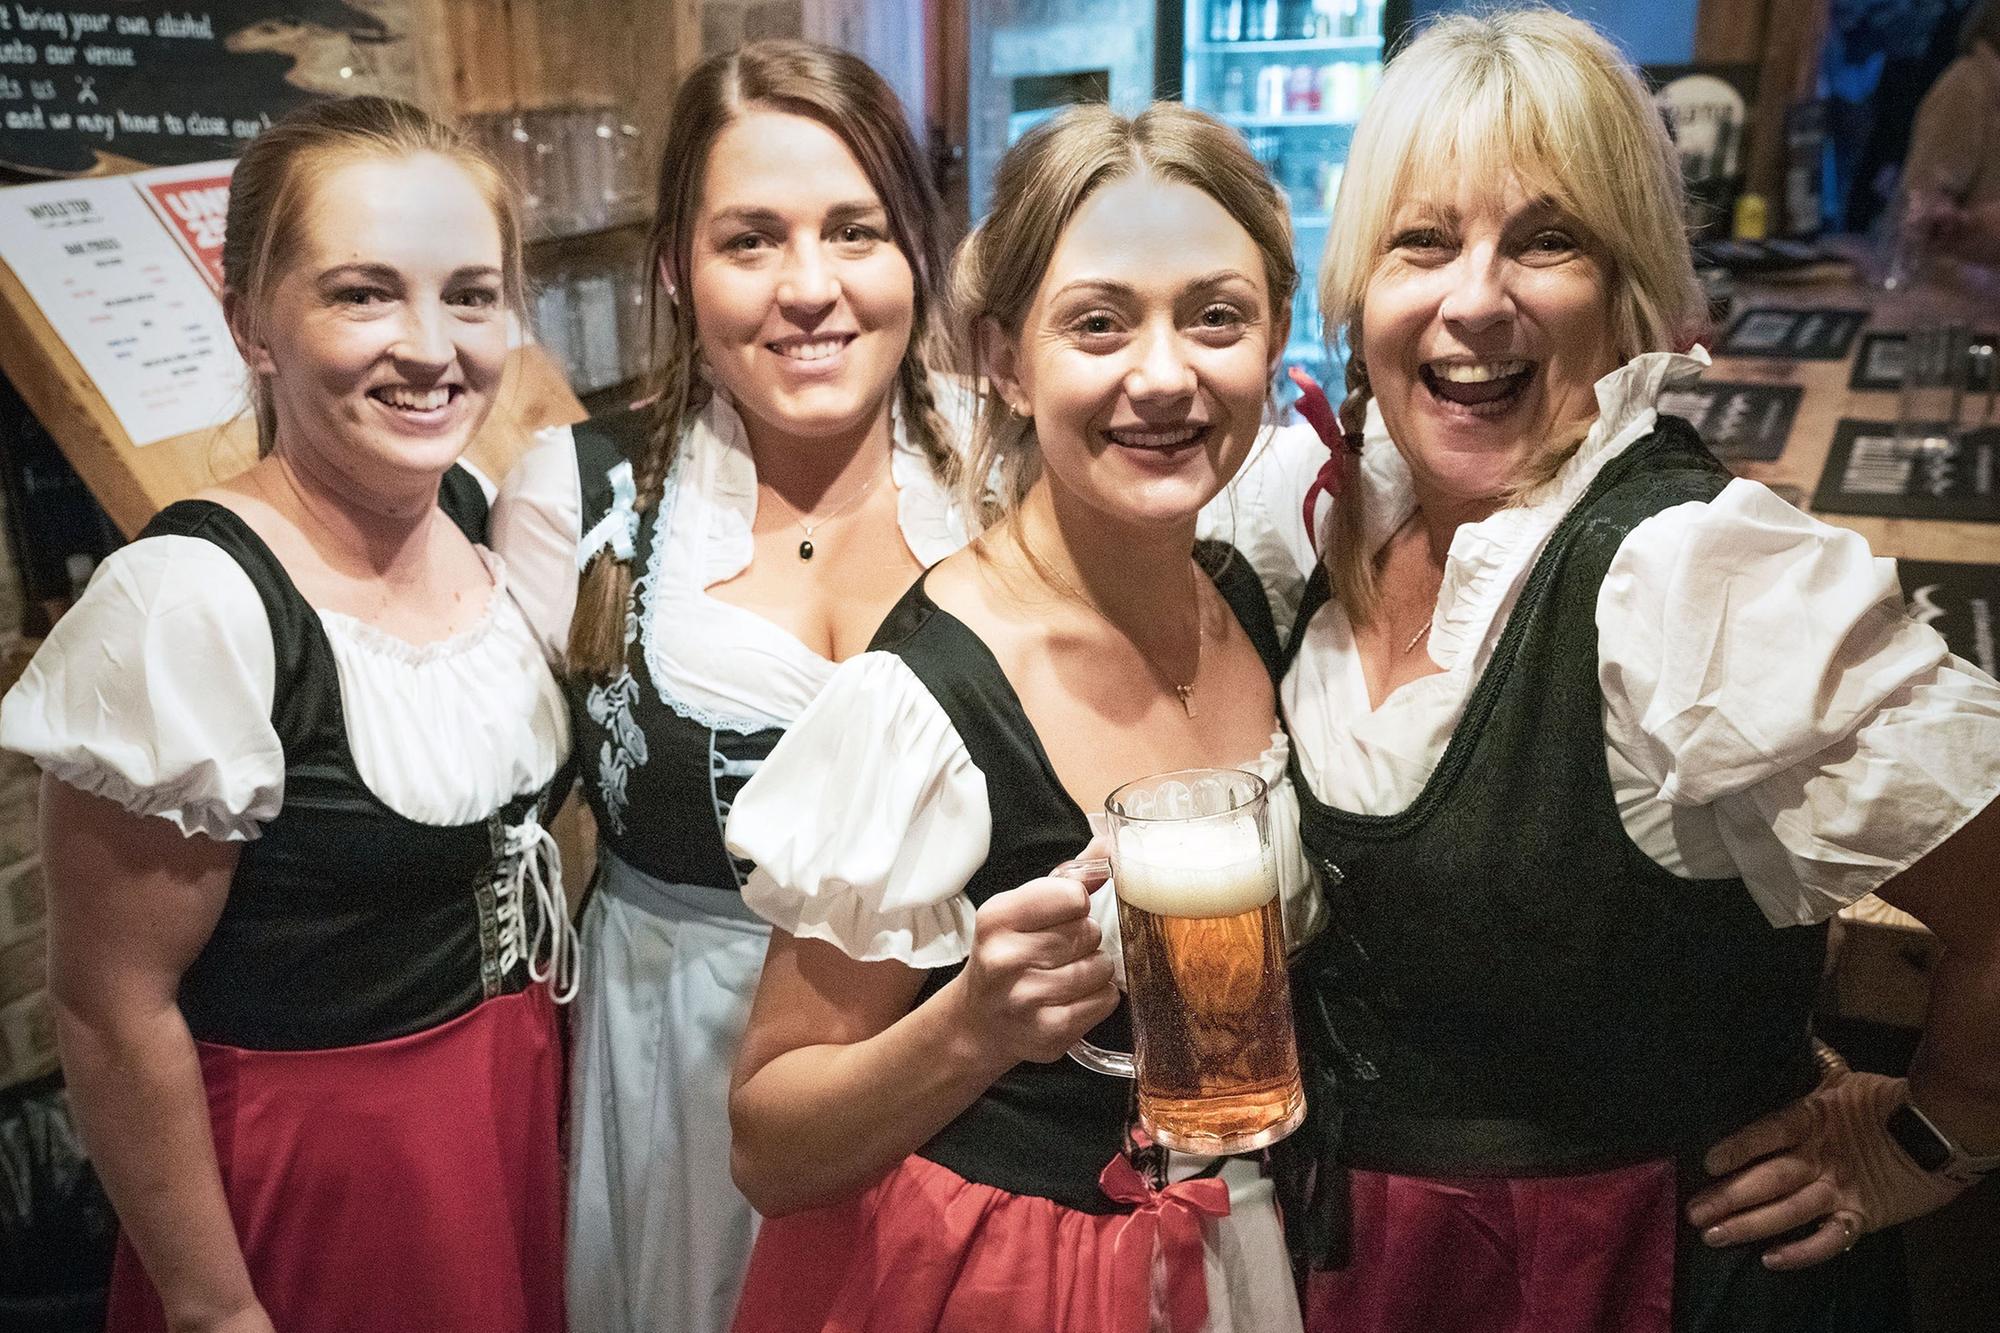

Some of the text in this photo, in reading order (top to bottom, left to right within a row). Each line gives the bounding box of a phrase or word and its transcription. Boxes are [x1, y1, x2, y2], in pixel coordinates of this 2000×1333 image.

[15, 3, 68, 39] bring
[69, 12, 111, 41] your
[49, 112, 72, 130] we
[163, 111, 186, 136] to
